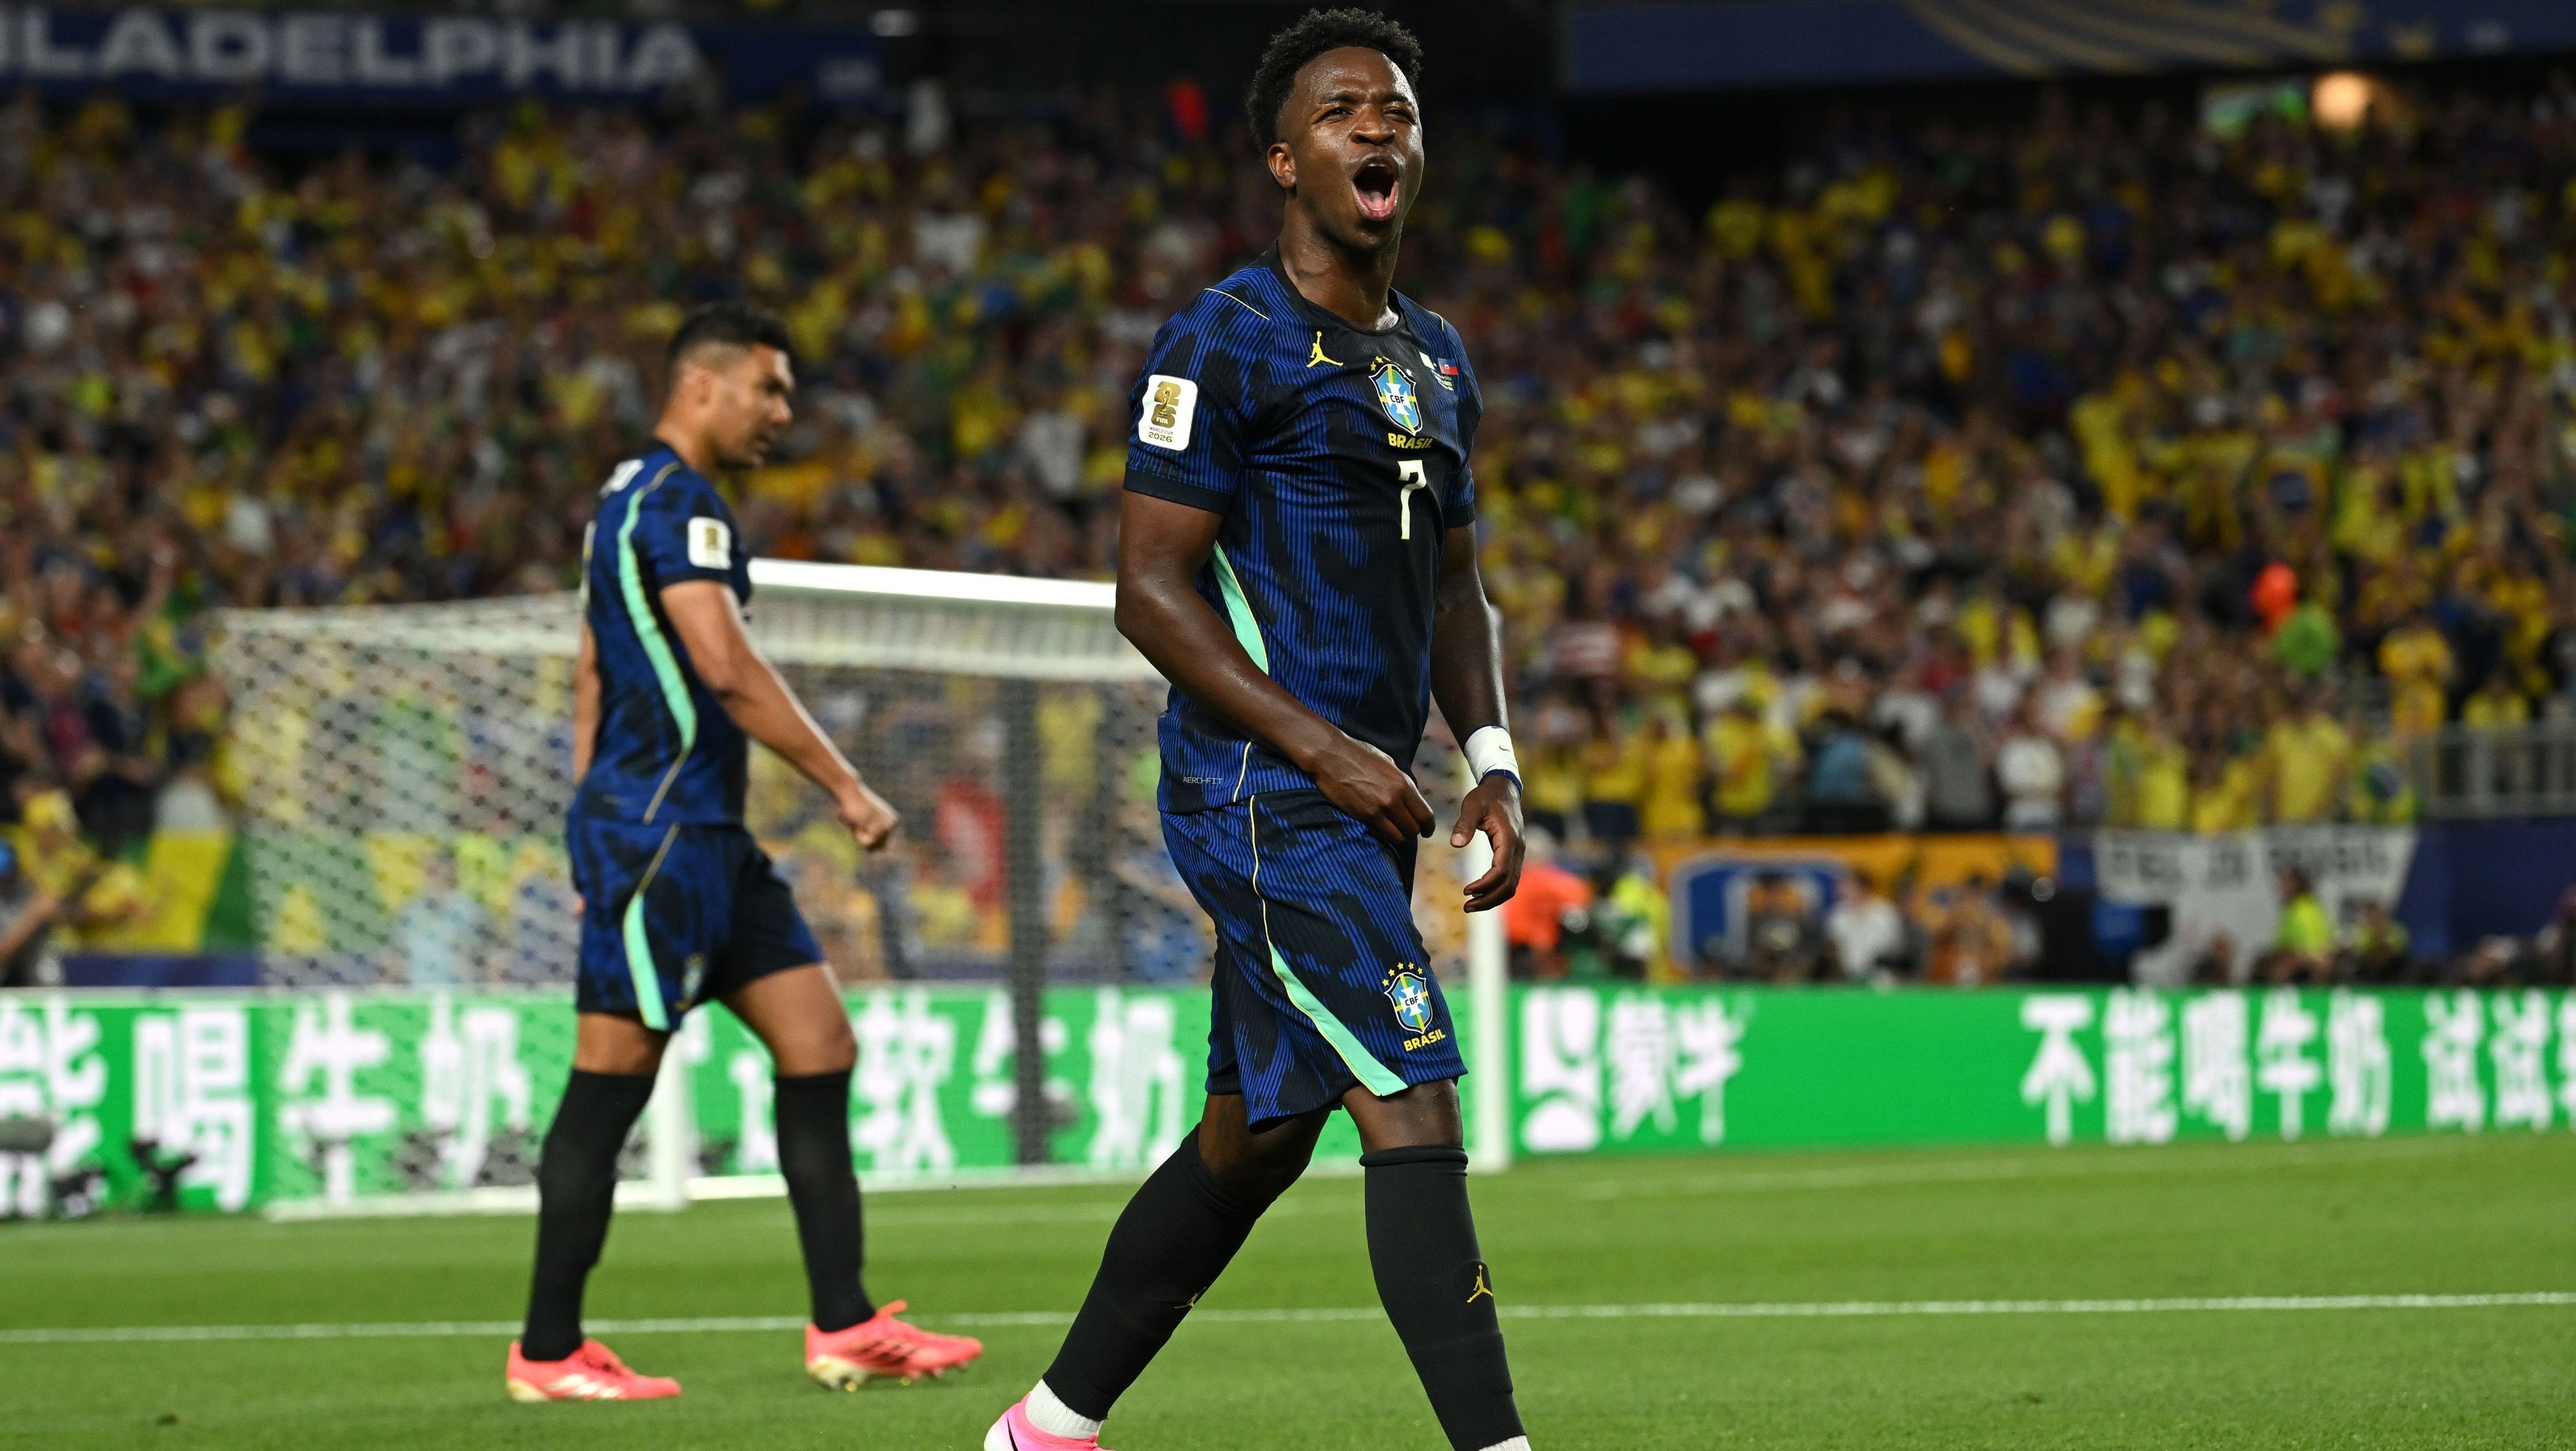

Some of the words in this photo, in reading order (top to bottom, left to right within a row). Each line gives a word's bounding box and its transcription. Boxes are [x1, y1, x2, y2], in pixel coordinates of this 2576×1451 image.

[1390, 395, 1405, 404] CBF
[1148, 431, 1172, 443] 2026
[1388, 432, 1433, 449] BRASIL
[1397, 459, 1427, 540] 7
[1183, 777, 1224, 785] AERO-FIT
[1405, 996, 1419, 1006] CBF
[1404, 1029, 1446, 1052] BRASIL
[2020, 985, 2391, 1147] 不能喝牛奶
[2419, 985, 2576, 1135] 试试
